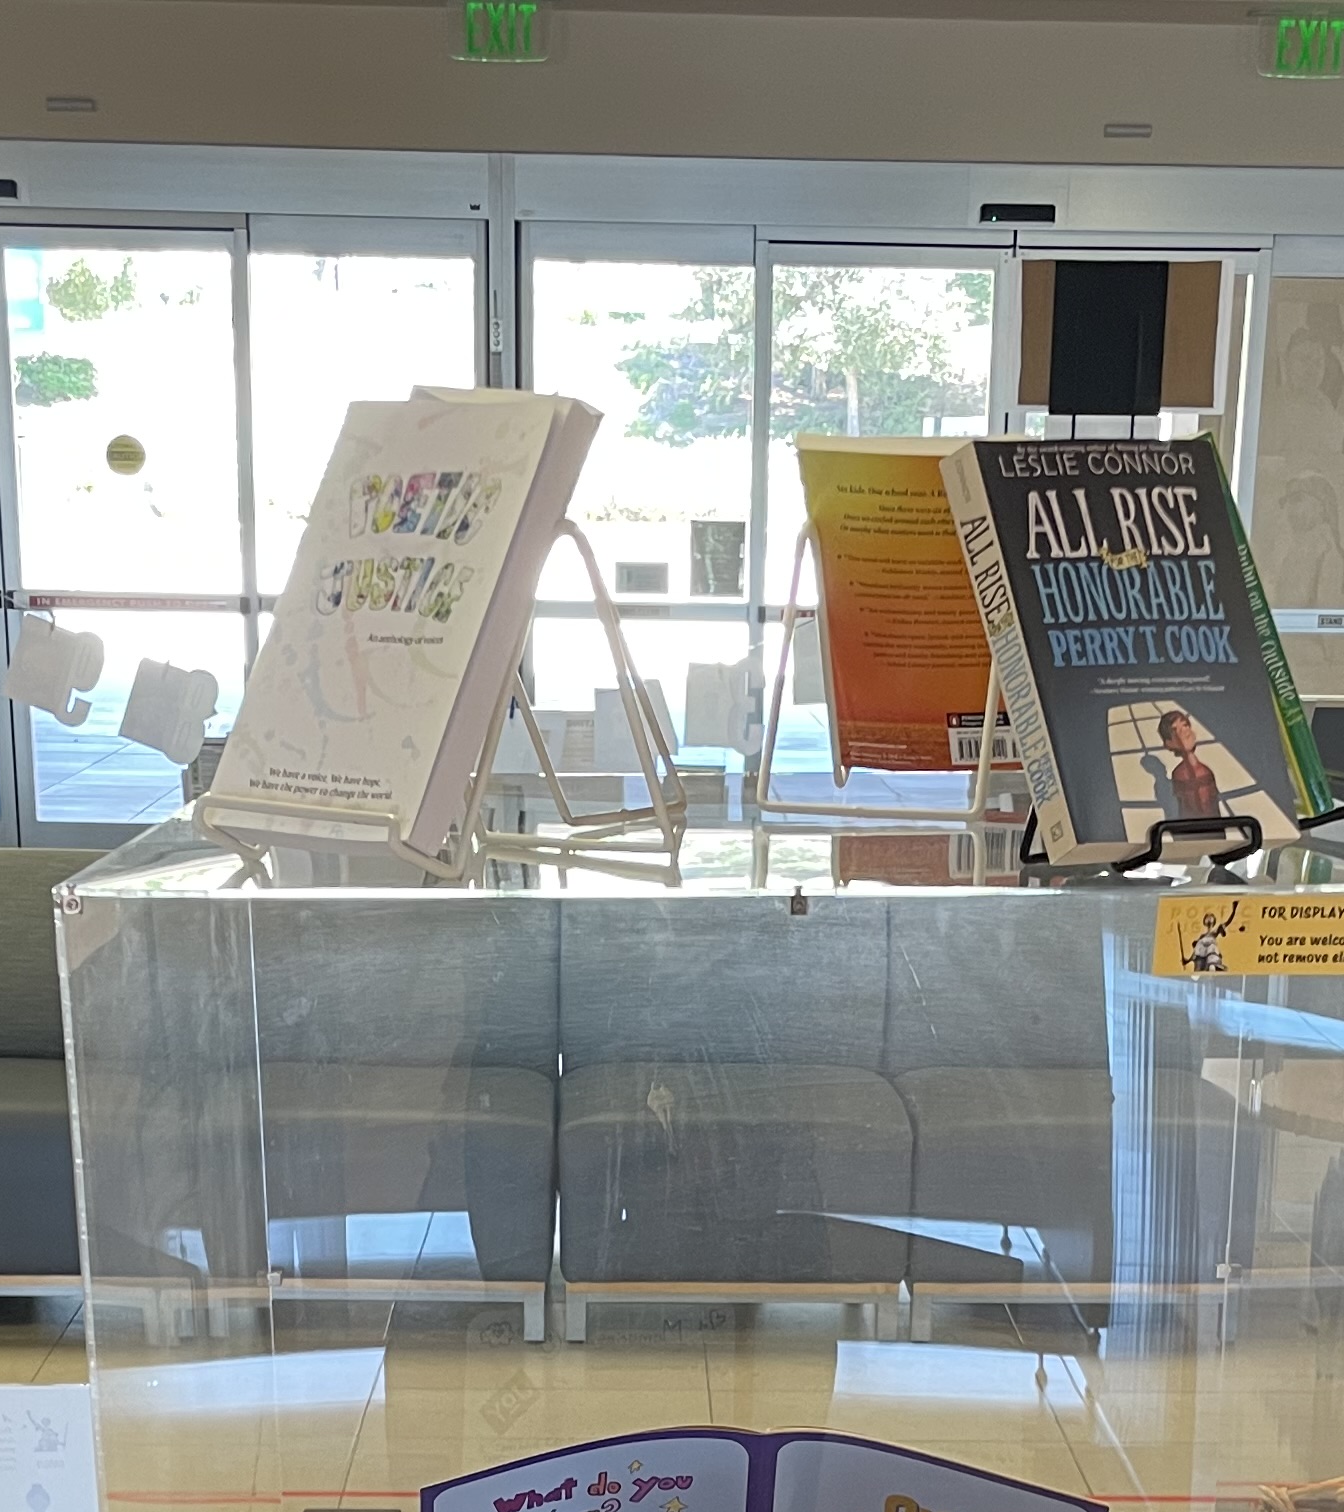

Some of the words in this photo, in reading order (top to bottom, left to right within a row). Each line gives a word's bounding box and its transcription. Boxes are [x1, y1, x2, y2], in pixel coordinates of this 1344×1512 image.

[466, 2, 537, 54] EXIT
[998, 452, 1079, 478] LESLIE
[1087, 451, 1196, 476] CONNOR
[348, 471, 503, 545] POETIC
[1025, 487, 1108, 560] ALL
[1109, 486, 1211, 557] RISE
[315, 557, 474, 624] JUSTICE
[960, 514, 988, 567] ALL
[974, 559, 1012, 627] RISE
[1030, 560, 1226, 625] HONORABLE
[1047, 627, 1138, 667] PERRY
[1139, 626, 1164, 665] T.
[1166, 625, 1239, 665] COOK
[991, 626, 1046, 753] HONORABLE
[1025, 757, 1053, 807] COOK
[1261, 906, 1287, 920] FOR
[1258, 952, 1279, 963] not
[1283, 953, 1328, 963] remove
[1259, 935, 1283, 947] You
[1286, 936, 1306, 946] are
[587, 1472, 621, 1495] do
[629, 1476, 693, 1502] you
